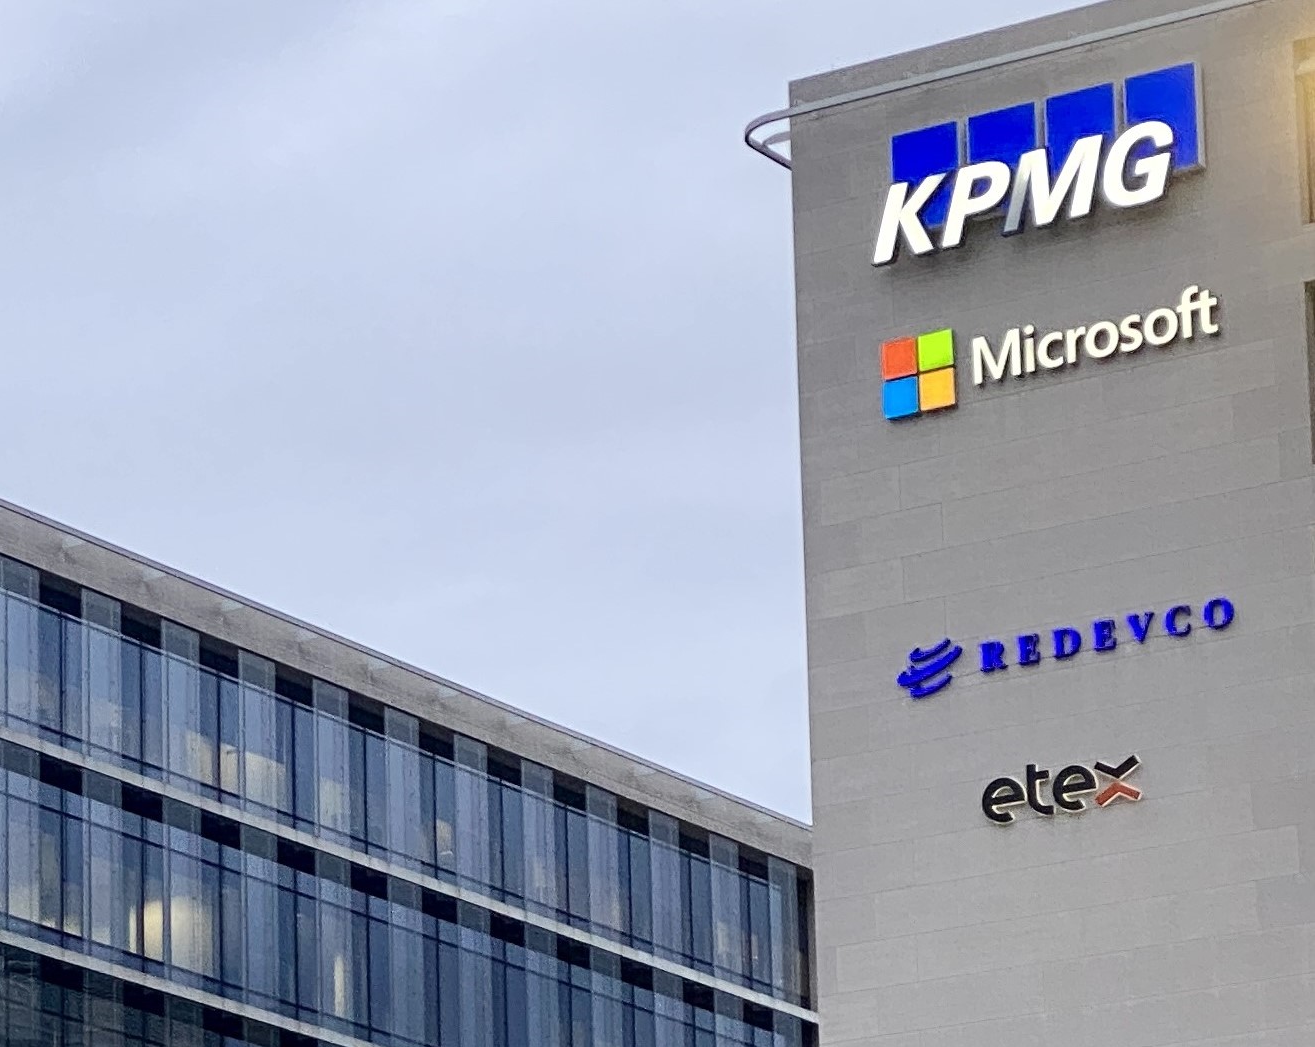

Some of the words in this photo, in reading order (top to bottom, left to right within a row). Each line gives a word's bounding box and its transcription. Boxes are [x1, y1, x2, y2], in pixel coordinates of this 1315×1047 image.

[872, 120, 1175, 266] KPMG
[972, 285, 1220, 385] Microsoft
[980, 597, 1235, 672] REDEVCO
[982, 754, 1142, 824] etex
